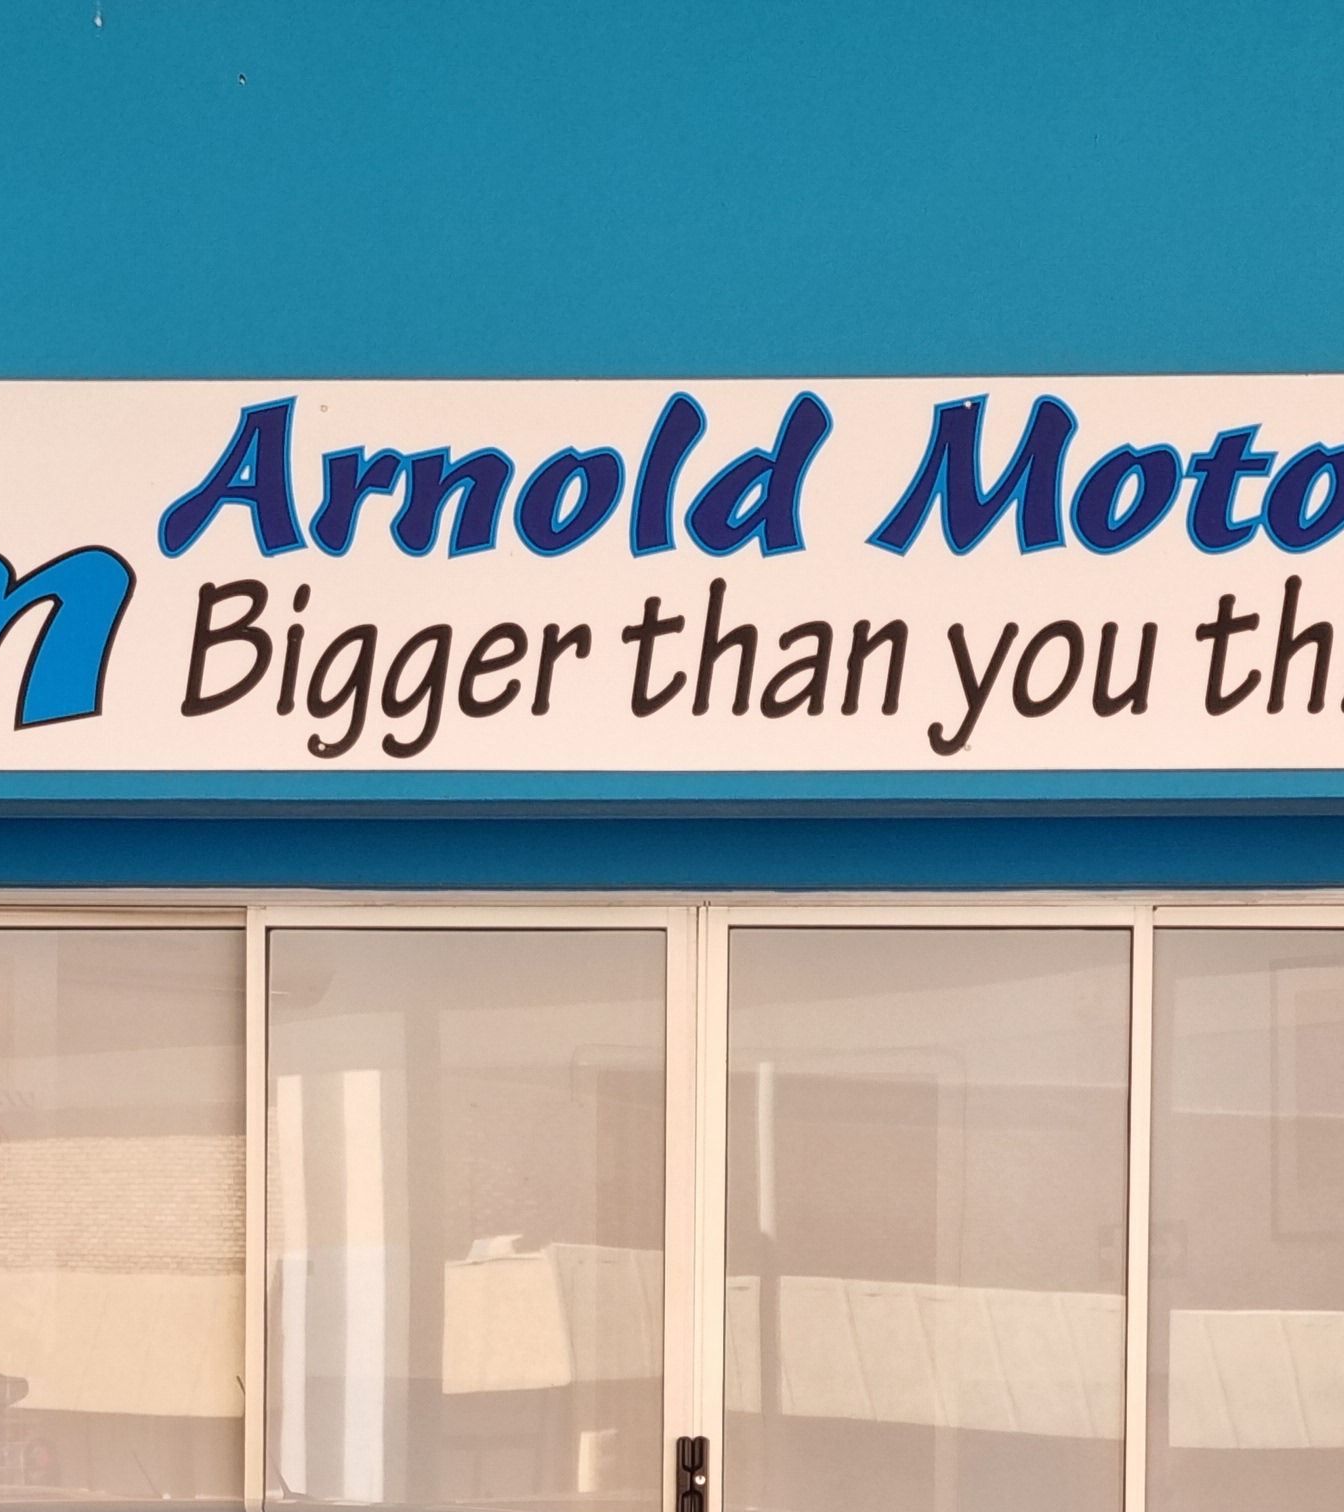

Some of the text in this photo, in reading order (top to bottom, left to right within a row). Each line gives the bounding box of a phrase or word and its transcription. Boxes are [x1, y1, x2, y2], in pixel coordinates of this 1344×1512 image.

[158, 391, 833, 559] Arnold
[181, 578, 592, 759] Bigger
[621, 577, 909, 717] than
[927, 620, 1160, 757] you
